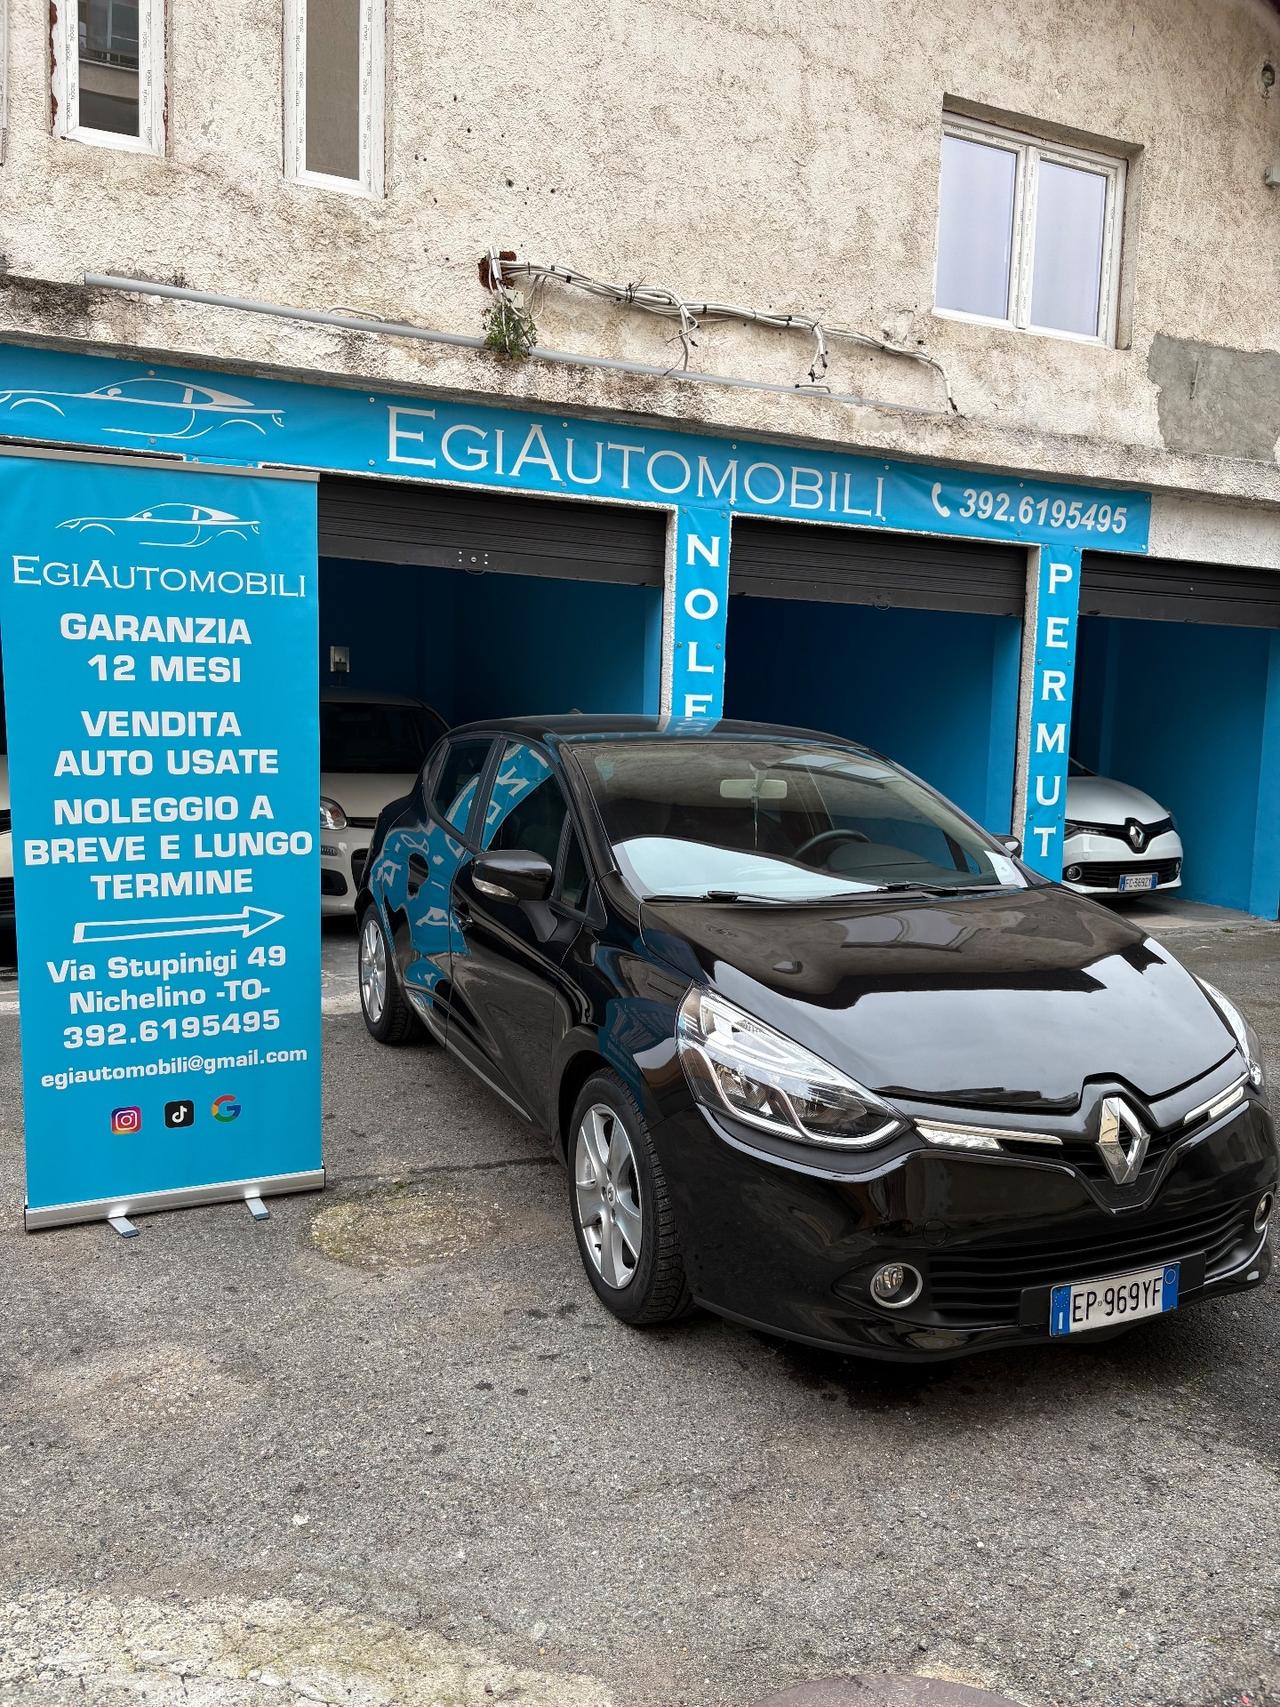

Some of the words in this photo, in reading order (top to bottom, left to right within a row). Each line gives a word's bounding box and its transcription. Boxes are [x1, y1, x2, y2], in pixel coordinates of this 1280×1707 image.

[959, 489, 1128, 535] 392.6195495
[60, 612, 252, 645] GARANZIA
[88, 654, 136, 681] 12
[150, 656, 241, 683] MESI
[81, 710, 242, 737] VENDITA
[1033, 562, 1073, 858] PERMUT
[53, 749, 153, 777] AUTO
[167, 748, 279, 775] USATE
[53, 795, 239, 826] NOLEGGIO
[250, 795, 275, 820] A
[24, 835, 146, 866] BREVE
[160, 834, 180, 860] E
[194, 830, 313, 859] LUNGO
[90, 868, 253, 900] TERMINE
[47, 959, 96, 984] Via
[107, 949, 238, 981] Stupinigi
[247, 945, 286, 967] 49
[69, 985, 206, 1015] Nichelino
[215, 977, 271, 1003] -TO-
[63, 1008, 280, 1049] 392.6195495
[41, 1048, 308, 1090] egiautomobili@gmail.com
